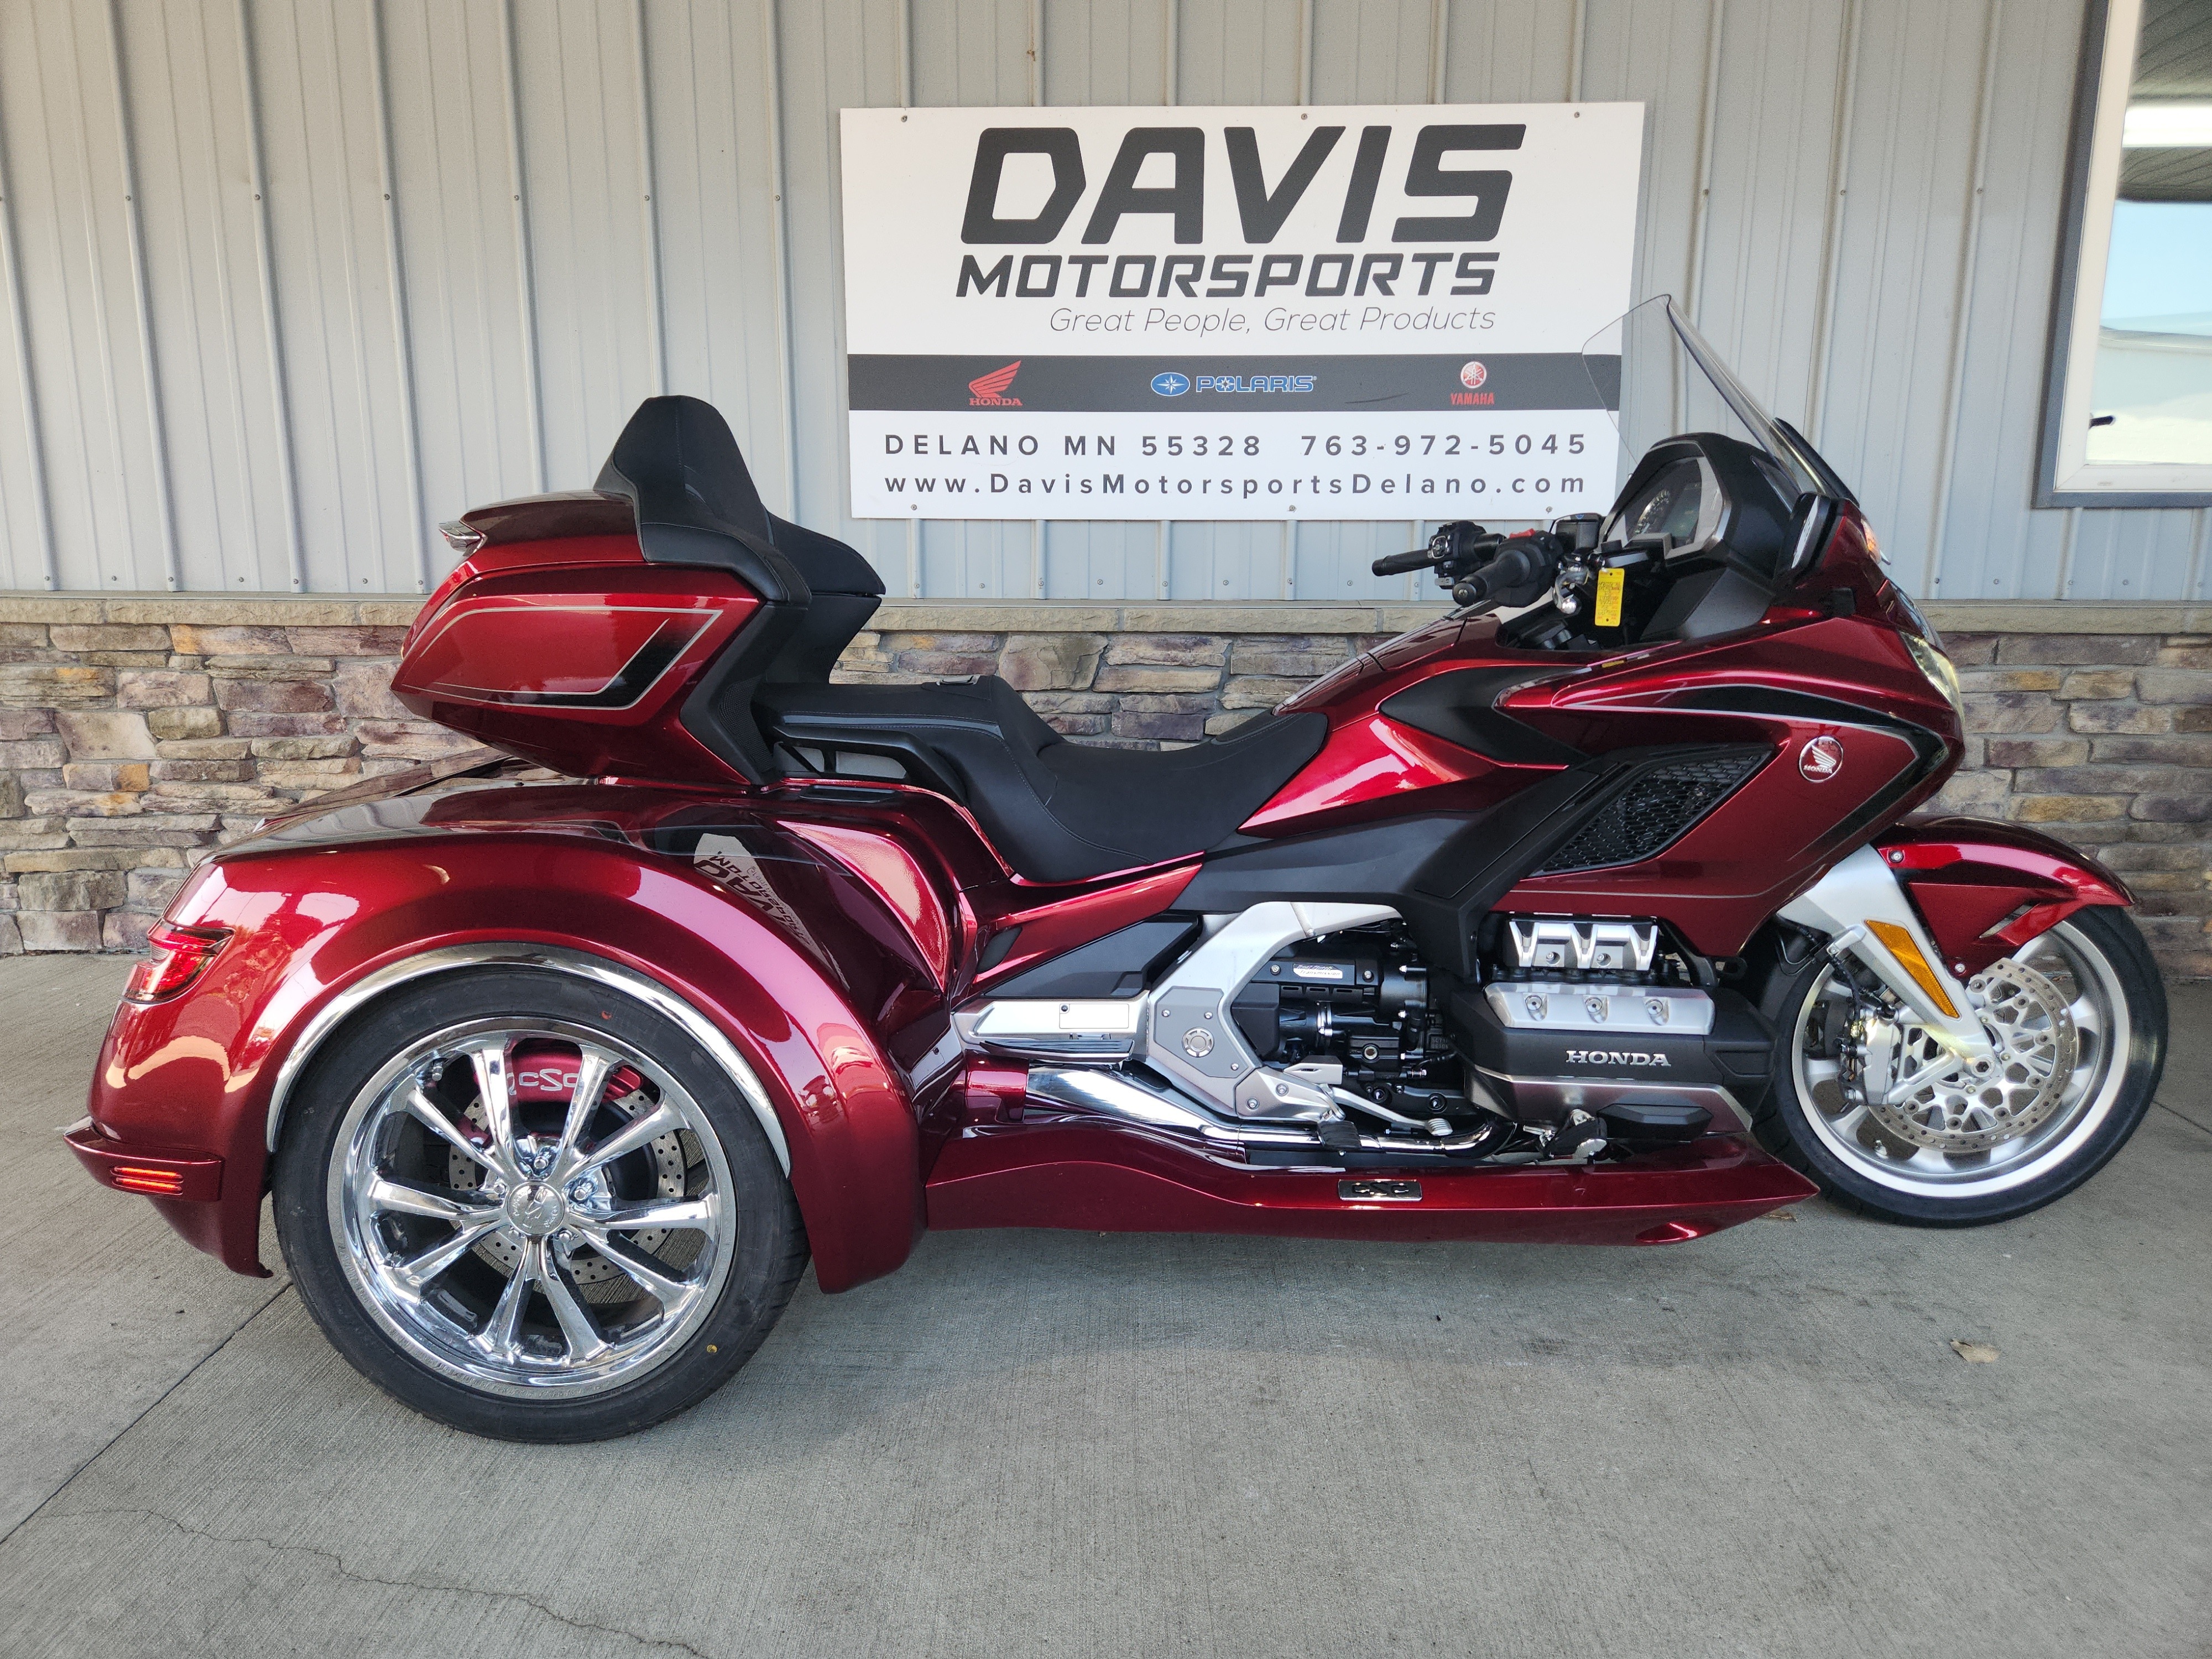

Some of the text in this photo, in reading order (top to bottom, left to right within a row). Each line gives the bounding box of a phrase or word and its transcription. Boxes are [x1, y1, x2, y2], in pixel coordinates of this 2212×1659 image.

[960, 123, 1527, 245] DAVIS
[955, 252, 1501, 298] MOTORSPORTS
[1050, 306, 1496, 338] Great People, Great Products
[1196, 375, 1314, 393] POLARIS
[969, 398, 1023, 406] HONDA
[1450, 392, 1495, 405] YAMAHA
[885, 434, 1585, 456] DELANO MN 55328 763-972-5045
[884, 473, 1584, 499] www.DavisMotorsportsDelano.com
[1803, 764, 1833, 774] HONDA
[1566, 1050, 1672, 1067] HONDA
